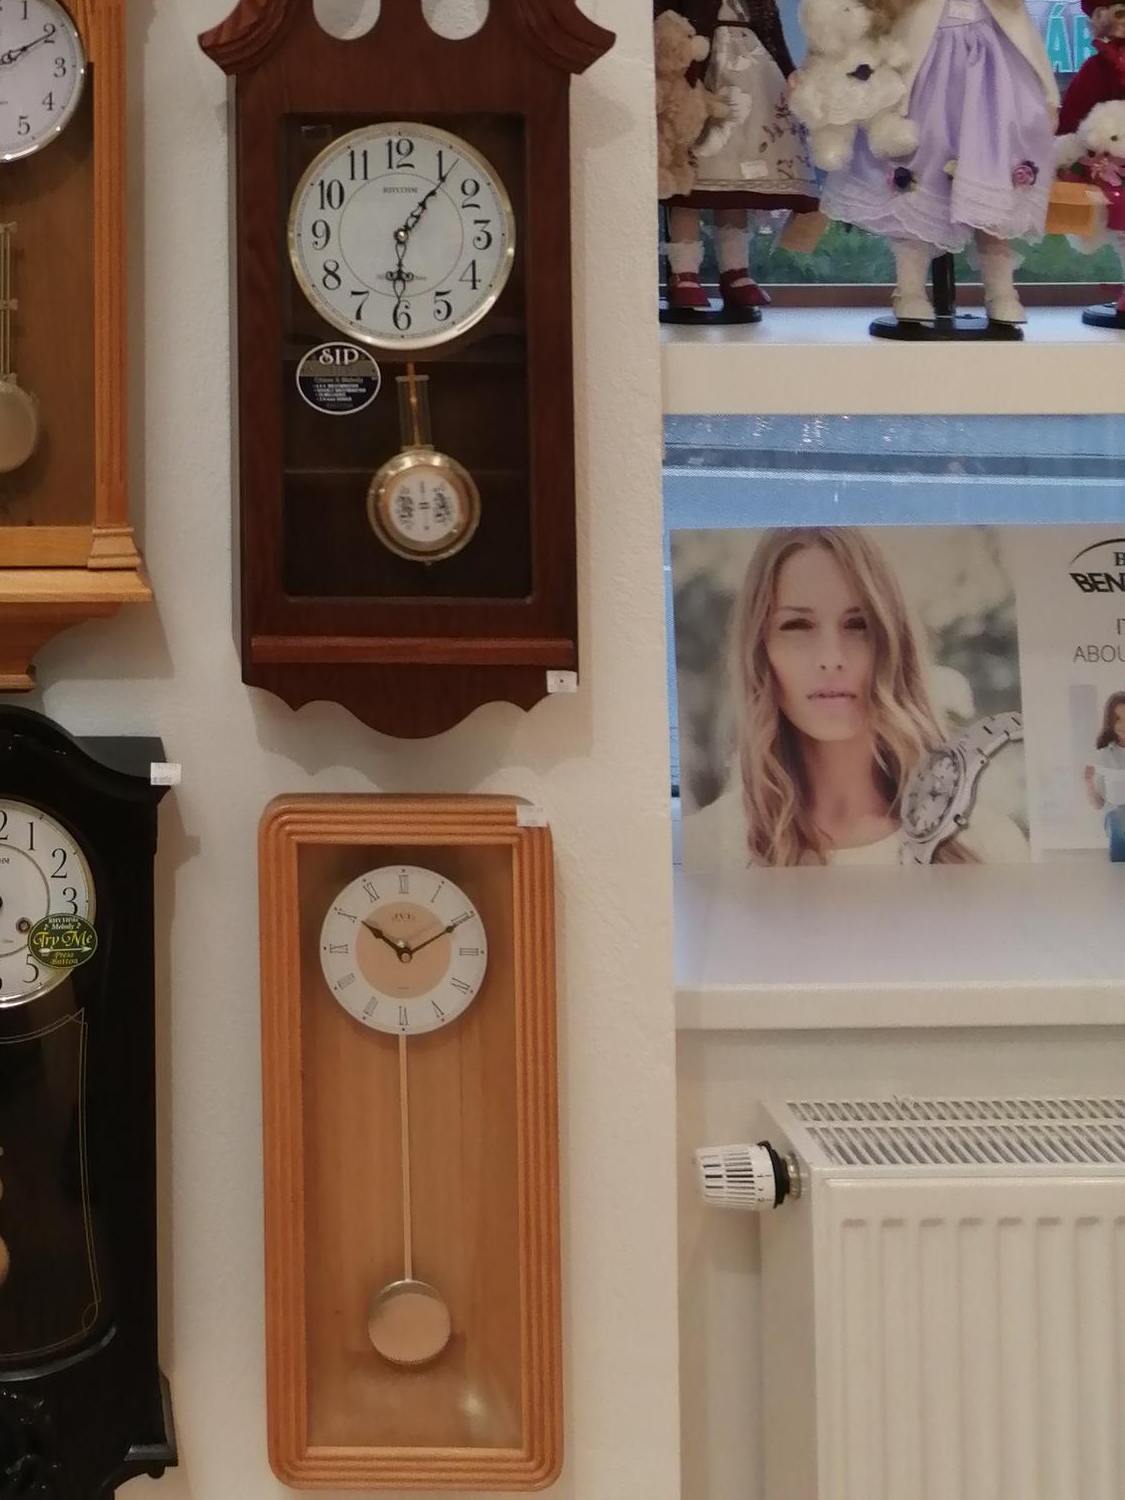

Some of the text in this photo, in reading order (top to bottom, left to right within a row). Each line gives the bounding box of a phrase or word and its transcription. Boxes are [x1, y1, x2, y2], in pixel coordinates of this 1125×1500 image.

[21, 1, 28, 20] 1
[43, 23, 57, 44] 2
[54, 57, 66, 78] 3
[42, 92, 56, 111] 4
[17, 115, 30, 136] 5
[348, 150, 369, 180] 11
[386, 138, 415, 170] 12
[436, 150, 445, 182] 1
[318, 179, 345, 210] 10
[461, 178, 481, 209] 2
[311, 219, 331, 250] 9
[473, 219, 493, 250] 3
[322, 260, 342, 290] 8
[458, 260, 482, 290] 4
[350, 291, 370, 321] 7
[392, 300, 412, 331] 6
[433, 290, 453, 321] 5
[28, 822, 36, 851] 1
[50, 848, 68, 879] 2
[62, 887, 78, 915] 3
[33, 931, 92, 949] Try Me
[23, 954, 39, 983] 5
